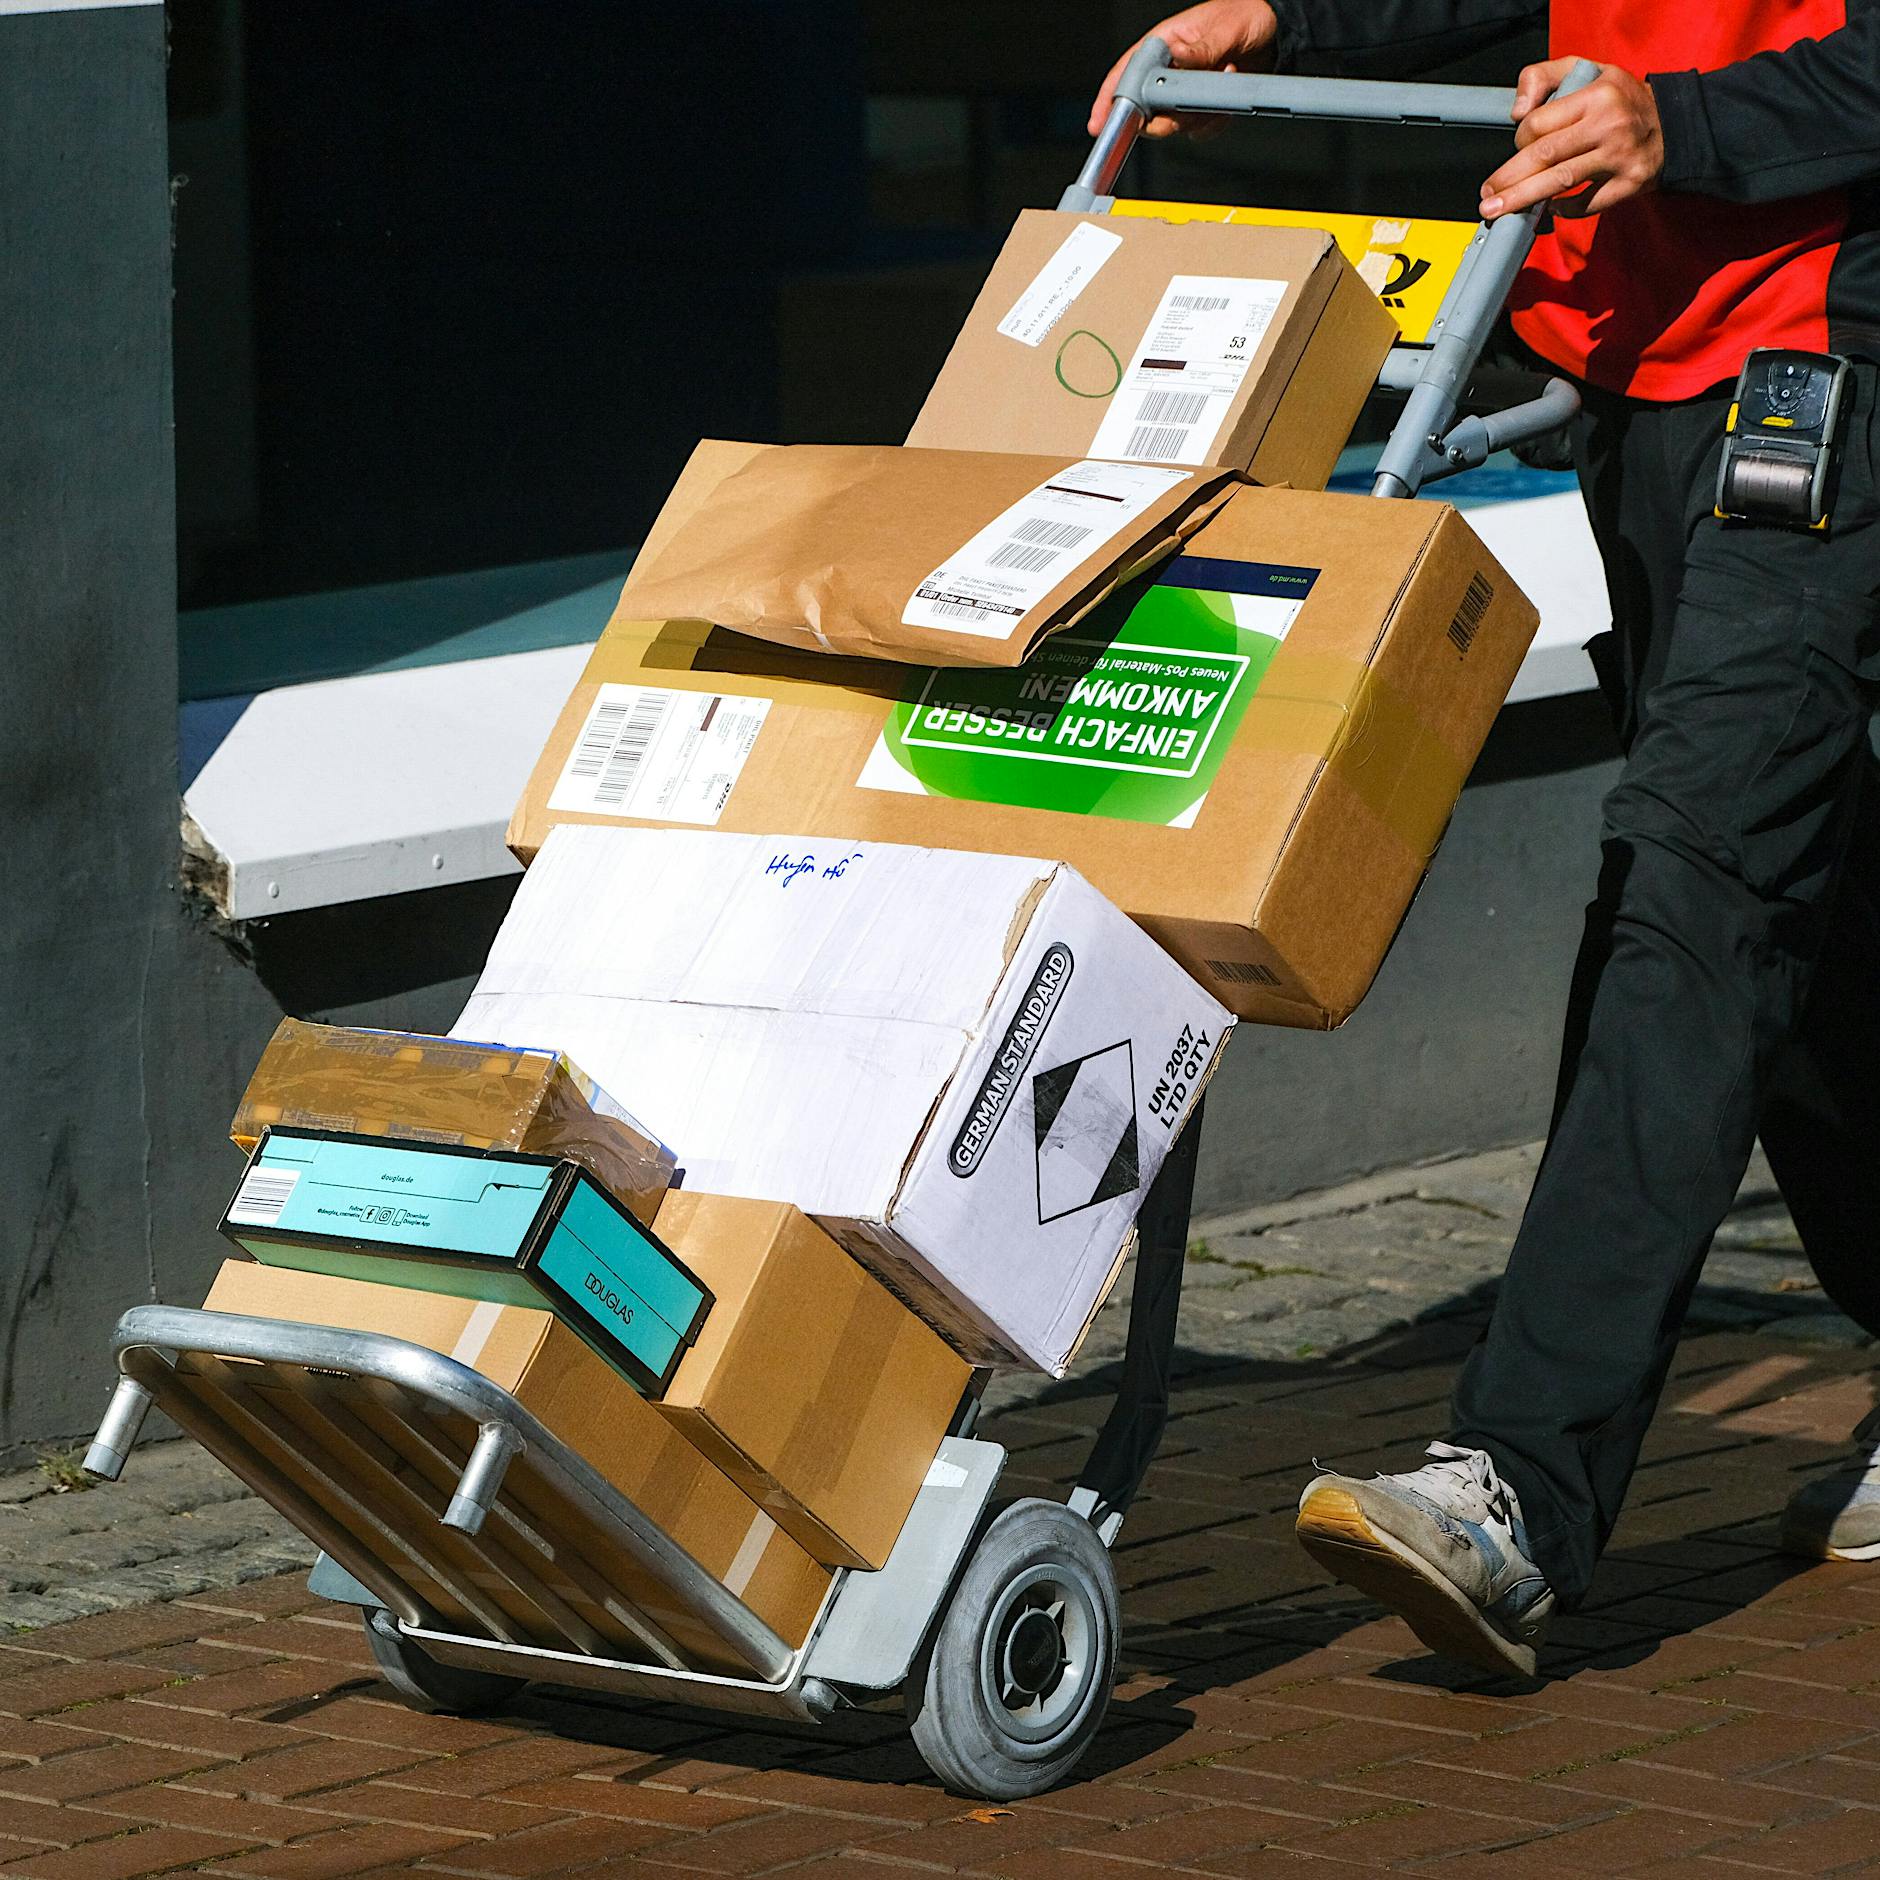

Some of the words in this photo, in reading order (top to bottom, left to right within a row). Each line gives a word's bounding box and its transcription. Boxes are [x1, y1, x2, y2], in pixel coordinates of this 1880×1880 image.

[1229, 336, 1247, 349] 53
[1269, 575, 1308, 584] www.md.de
[1049, 652, 1088, 668] deinen
[1089, 656, 1109, 670] für
[1110, 658, 1189, 678] PoS-Material
[1191, 666, 1230, 682] Neues
[1018, 672, 1219, 719] ANKOMMEN!
[923, 700, 1055, 742] BESSER
[1054, 715, 1198, 760] EINFACH
[955, 1070, 1012, 1168] GERMAN
[1001, 951, 1066, 1075] STANDARD
[1148, 1077, 1171, 1115] UN
[1165, 1023, 1194, 1080] 2037
[1160, 1082, 1187, 1130] LTD
[1184, 1029, 1211, 1080] QTY
[381, 1173, 414, 1183] douglas.de
[406, 1212, 430, 1220] Download
[585, 1272, 634, 1325] DOUGLAS
